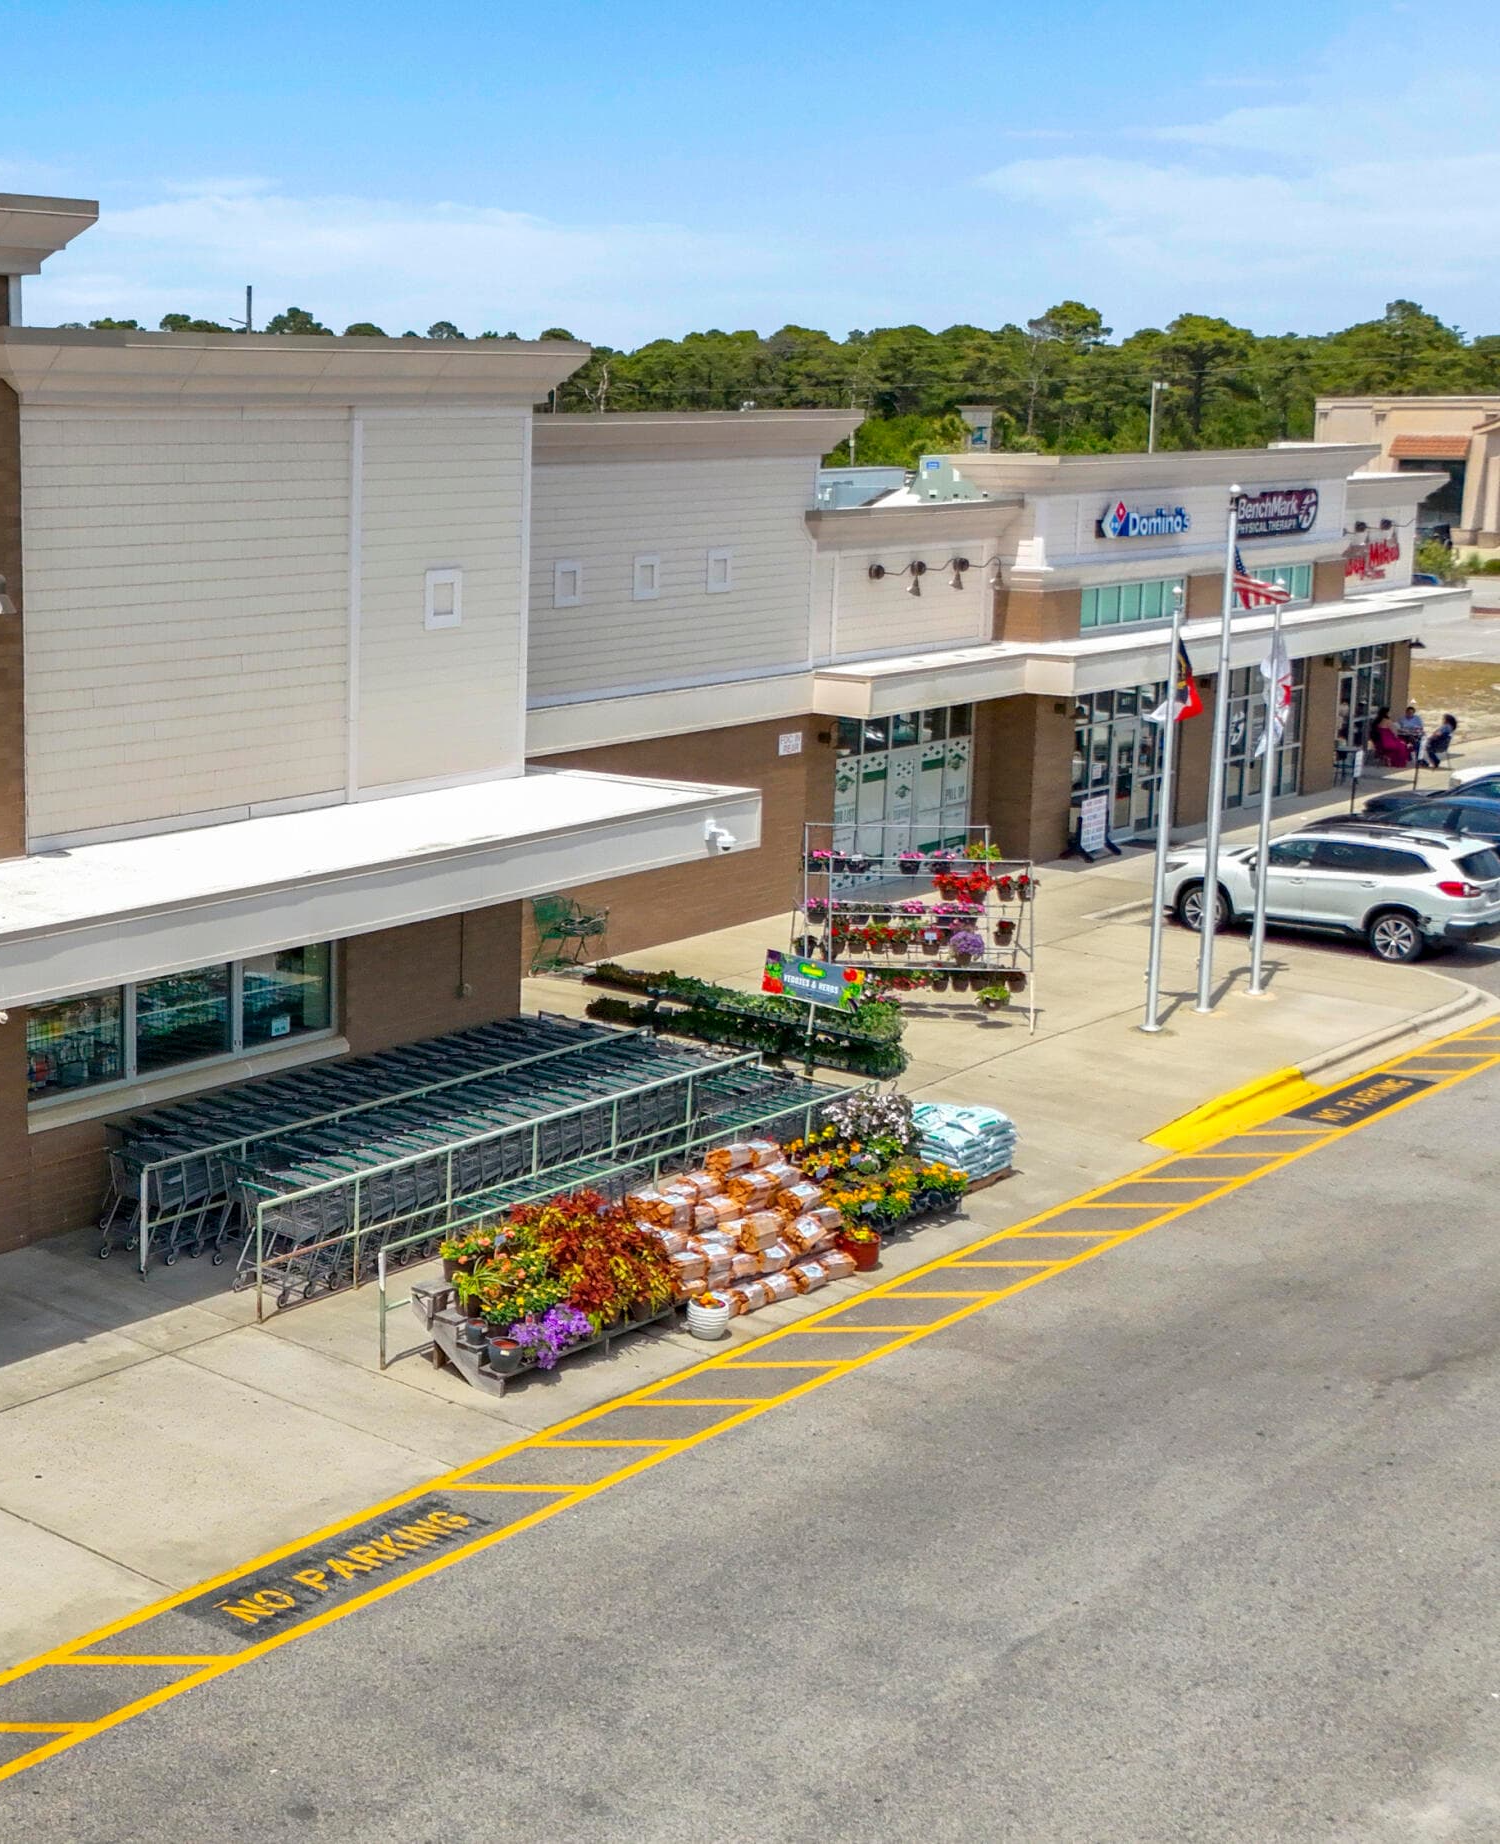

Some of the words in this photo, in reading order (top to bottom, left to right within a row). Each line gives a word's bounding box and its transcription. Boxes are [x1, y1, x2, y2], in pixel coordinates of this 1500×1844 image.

[1129, 506, 1191, 536] Domino's
[1238, 496, 1299, 520] BenchMark
[1268, 517, 1298, 533] THERAPY
[818, 982, 839, 995] HERBS
[1310, 1107, 1351, 1122] NO
[1335, 1078, 1414, 1111] PARKING
[220, 1589, 296, 1624] NO
[291, 1511, 470, 1591] PARKING
